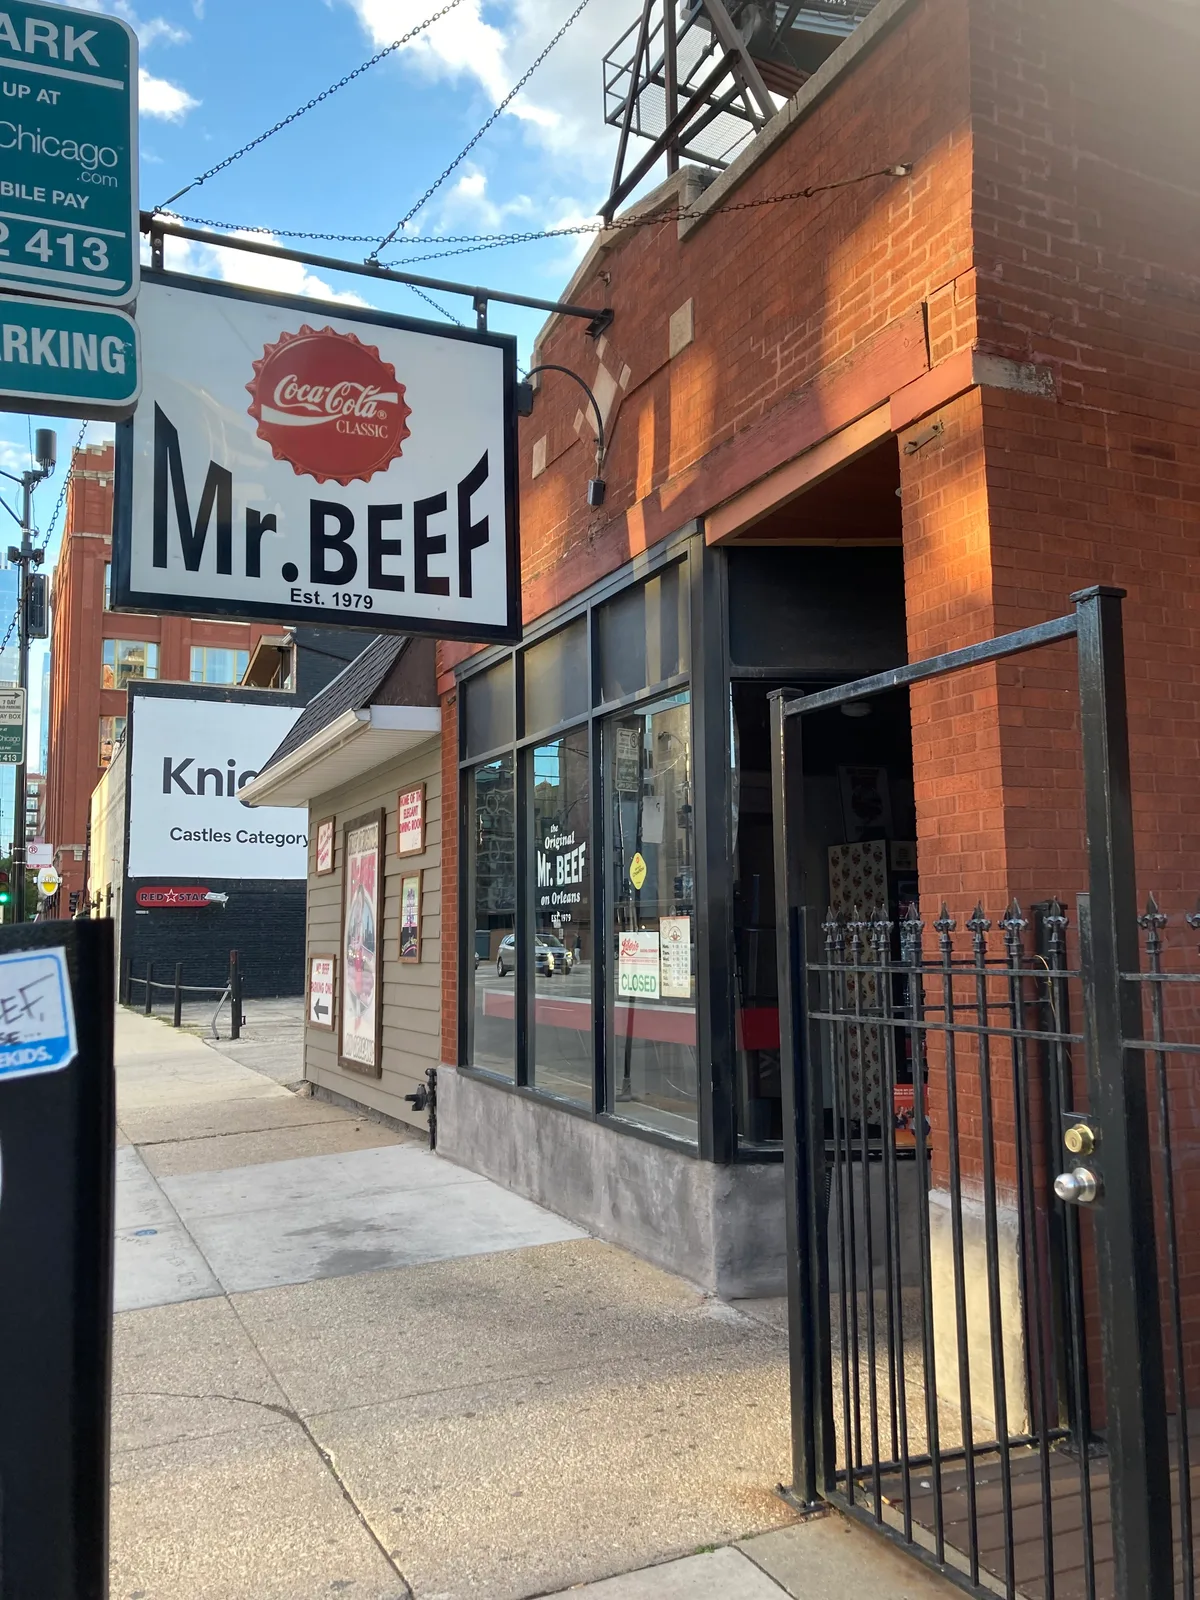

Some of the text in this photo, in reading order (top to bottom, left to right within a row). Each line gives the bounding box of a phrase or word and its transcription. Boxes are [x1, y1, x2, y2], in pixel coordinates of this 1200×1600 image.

[3, 81, 61, 105] UP AT
[76, 171, 118, 188] .com
[52, 190, 89, 209] PAY
[25, 228, 109, 272] 413
[0, 323, 126, 374] RKING
[273, 374, 386, 418] Coca-Cola
[336, 420, 388, 439] CLASSIC
[153, 400, 490, 598] Mr. BEEF
[290, 588, 373, 609] Est. 1979
[170, 827, 231, 843] Castles
[236, 830, 308, 847] Category
[544, 830, 575, 850] Original
[537, 841, 586, 887] Mr. BEEF
[141, 893, 163, 901] RED
[540, 891, 581, 906] on Orleans
[621, 973, 657, 993] CLOSED
